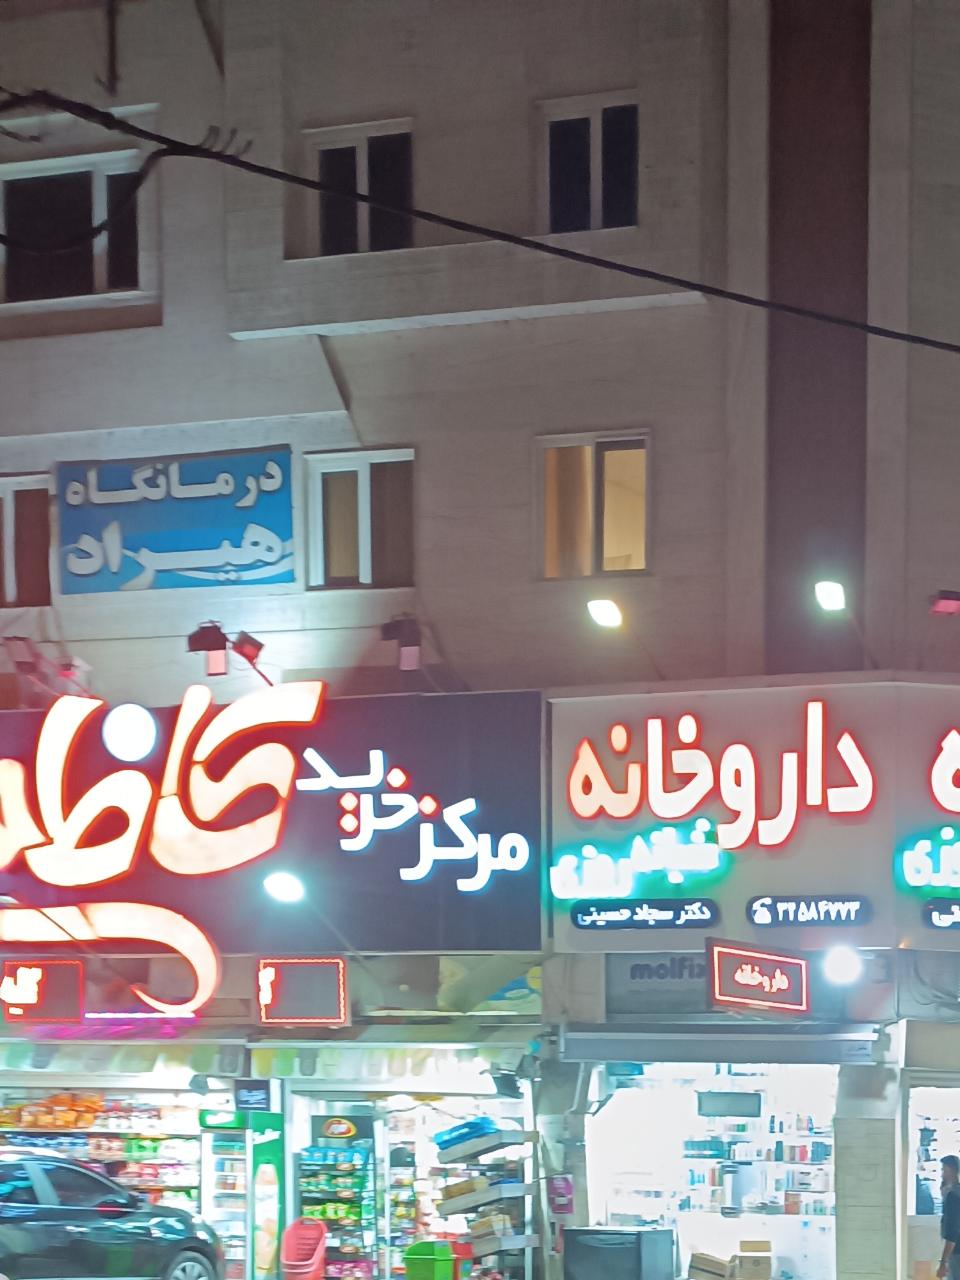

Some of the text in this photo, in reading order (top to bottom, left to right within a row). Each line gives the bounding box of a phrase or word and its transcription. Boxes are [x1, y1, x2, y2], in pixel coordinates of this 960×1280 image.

[65, 460, 284, 508] درمانگاه
[66, 519, 286, 590] هیراد
[295, 747, 530, 892] مرکز خرید
[569, 700, 874, 850] داروخانه
